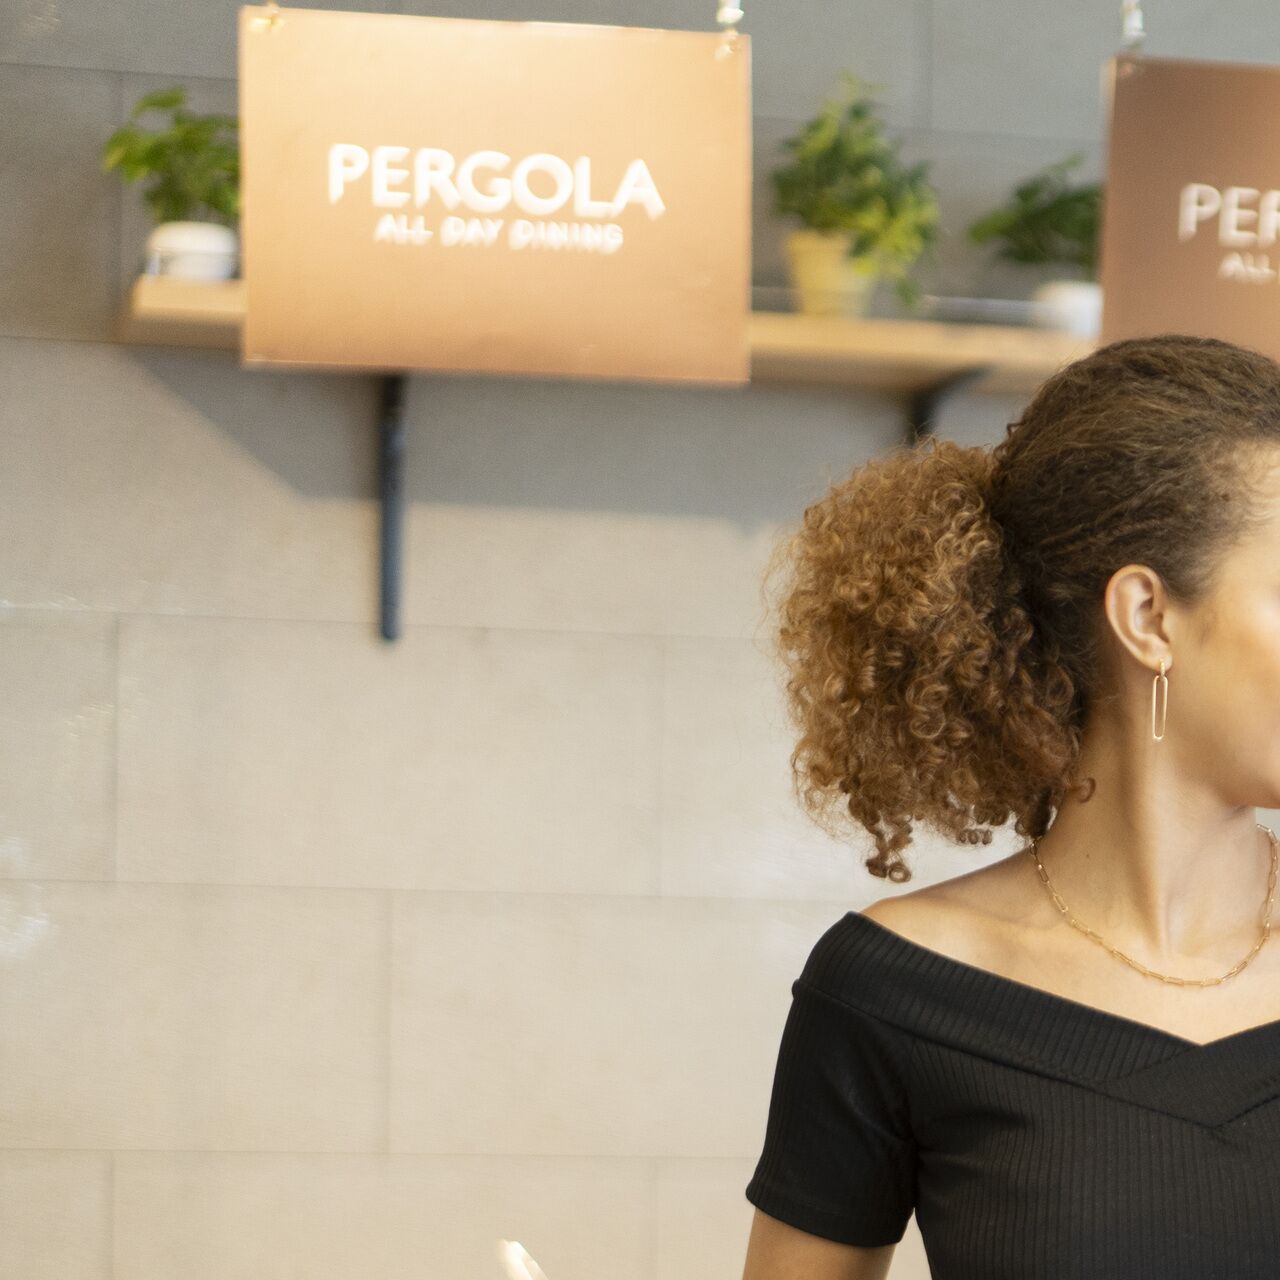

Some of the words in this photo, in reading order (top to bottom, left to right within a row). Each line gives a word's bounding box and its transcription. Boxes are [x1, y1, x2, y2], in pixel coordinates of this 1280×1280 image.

[328, 143, 666, 221] PERGOLA
[374, 213, 434, 246] ALL
[440, 215, 504, 248] DAY
[508, 219, 624, 255] DINING
[1217, 252, 1276, 285] ALL
